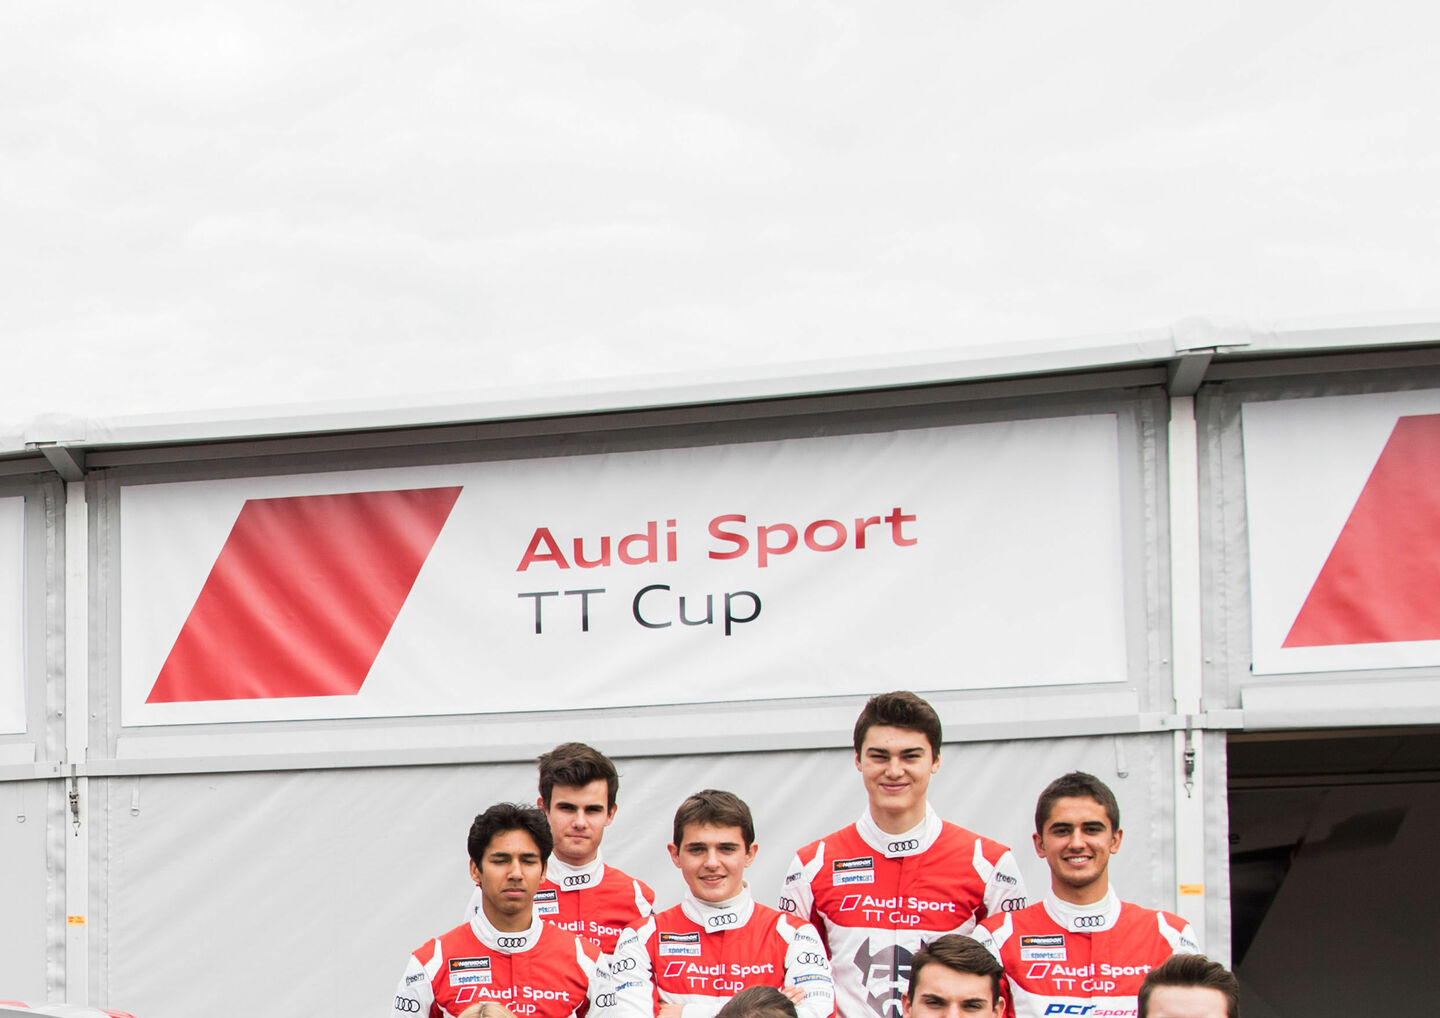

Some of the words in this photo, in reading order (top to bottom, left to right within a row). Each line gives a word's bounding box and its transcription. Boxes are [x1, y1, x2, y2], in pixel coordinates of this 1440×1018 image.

[516, 519, 677, 572] Audi
[708, 507, 918, 568] Sport
[517, 588, 606, 635] TT
[632, 584, 762, 636] Cup
[862, 896, 903, 908] Audi
[908, 897, 956, 912] Sport
[862, 909, 884, 921] TT
[889, 911, 921, 927] Cup
[589, 921, 622, 936] Sport
[686, 962, 726, 976] Audi
[731, 963, 774, 978] Sport
[1051, 963, 1095, 977] Audi
[1100, 964, 1151, 978] Sport
[687, 976, 708, 989] TT
[713, 978, 744, 993] Cup
[1052, 979, 1076, 990] TT
[1081, 979, 1116, 993] Cup
[478, 986, 518, 999] Audi
[522, 987, 570, 1002] Sport
[505, 1001, 537, 1016] Cup
